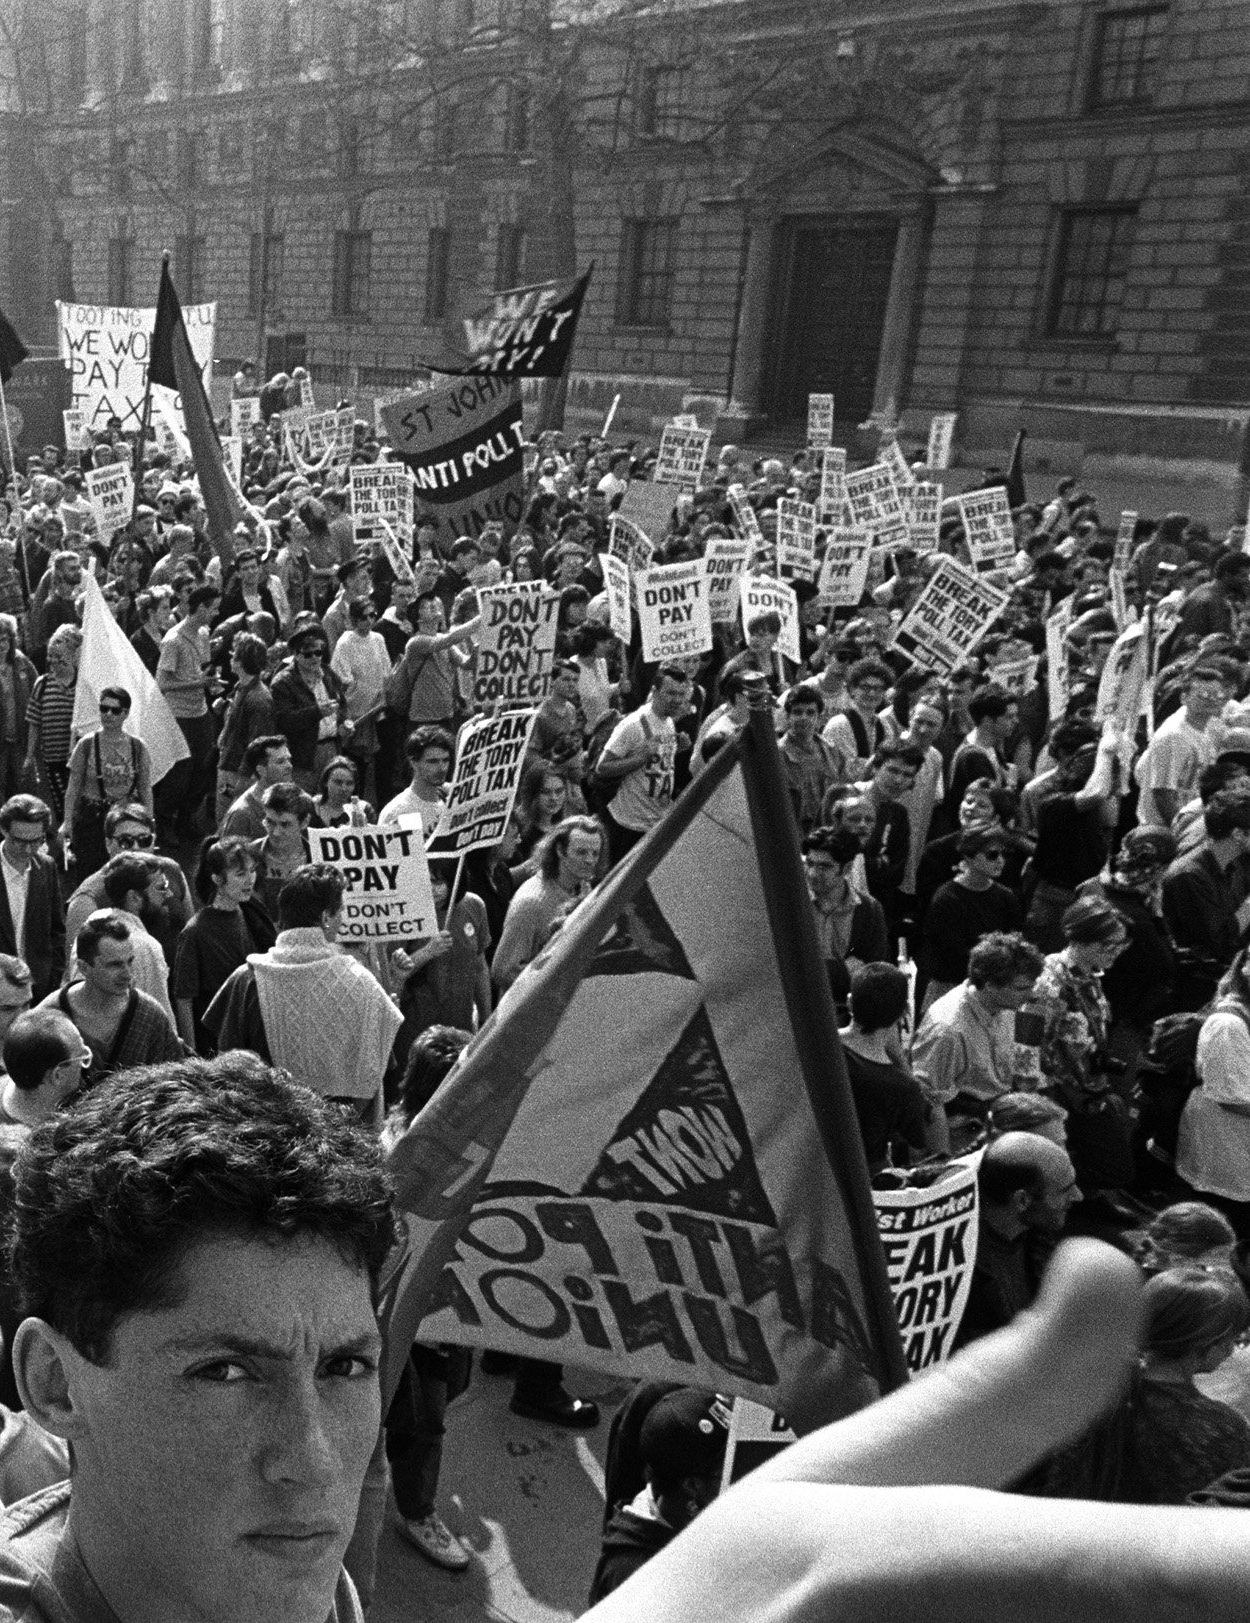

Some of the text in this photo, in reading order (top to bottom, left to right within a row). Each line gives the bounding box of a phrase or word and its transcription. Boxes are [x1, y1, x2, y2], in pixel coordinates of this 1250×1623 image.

[66, 307, 142, 327] TOOTING
[495, 290, 557, 319] WE
[65, 327, 101, 355] WE
[70, 357, 125, 389] PAY
[401, 404, 433, 441] ST
[407, 458, 460, 490] ANTI
[462, 431, 514, 478] POLL
[92, 474, 128, 496] DON'T
[377, 487, 397, 500] TOR
[103, 491, 126, 508] PAY
[354, 501, 380, 514] POLL
[706, 557, 746, 574] DON'T
[644, 580, 701, 607] DON'T
[710, 577, 733, 593] PAY
[934, 572, 995, 621] BREAK
[488, 595, 562, 628] DON'T
[659, 603, 694, 626] PAY
[915, 601, 946, 631] POLL
[925, 586, 983, 635] THE TORY
[497, 623, 540, 650] PAY
[652, 638, 707, 658] COLLECT
[660, 628, 697, 644] DON'T
[479, 645, 553, 676] DON'T
[473, 672, 550, 702] COLLECT
[461, 715, 532, 758] BREAK
[456, 740, 524, 784] THE TORY
[447, 765, 518, 809] POLL TAX
[319, 829, 413, 862] DON'T
[343, 864, 400, 892] PAY
[346, 901, 408, 919] DON'T
[337, 918, 426, 937] COLLECT
[912, 1191, 974, 1228] Worker
